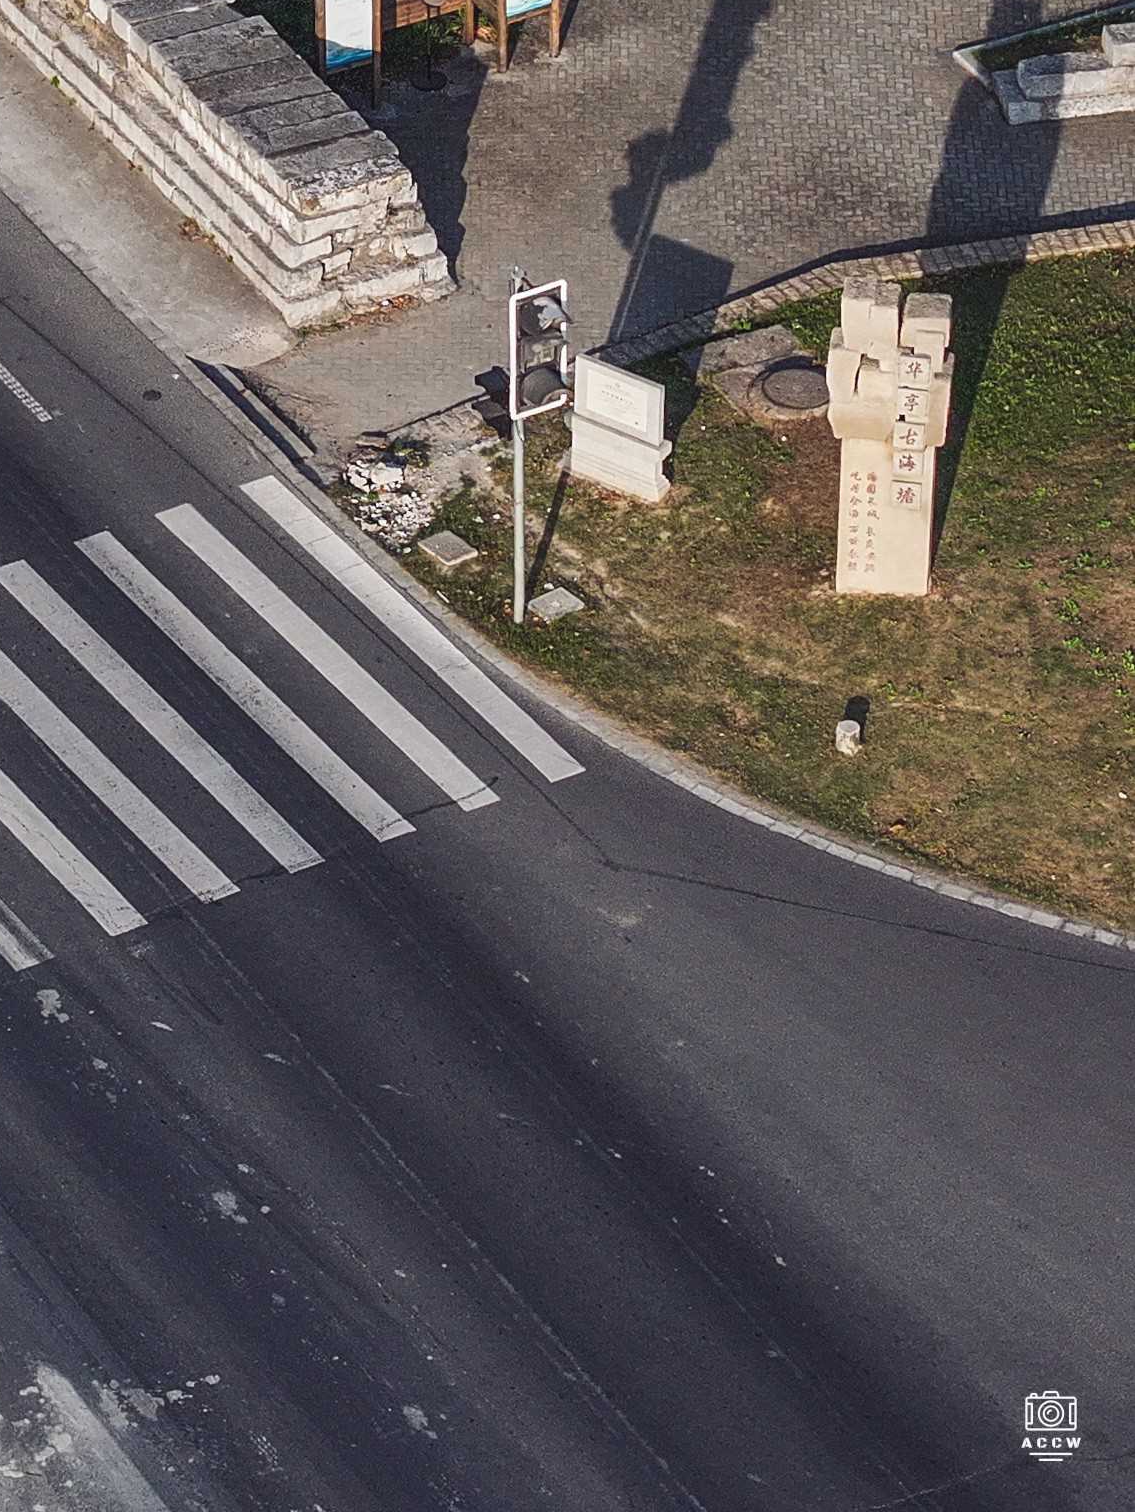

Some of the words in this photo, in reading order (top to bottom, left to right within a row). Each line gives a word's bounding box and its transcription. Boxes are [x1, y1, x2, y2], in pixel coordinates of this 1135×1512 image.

[896, 360, 923, 503] 华亭古海塘
